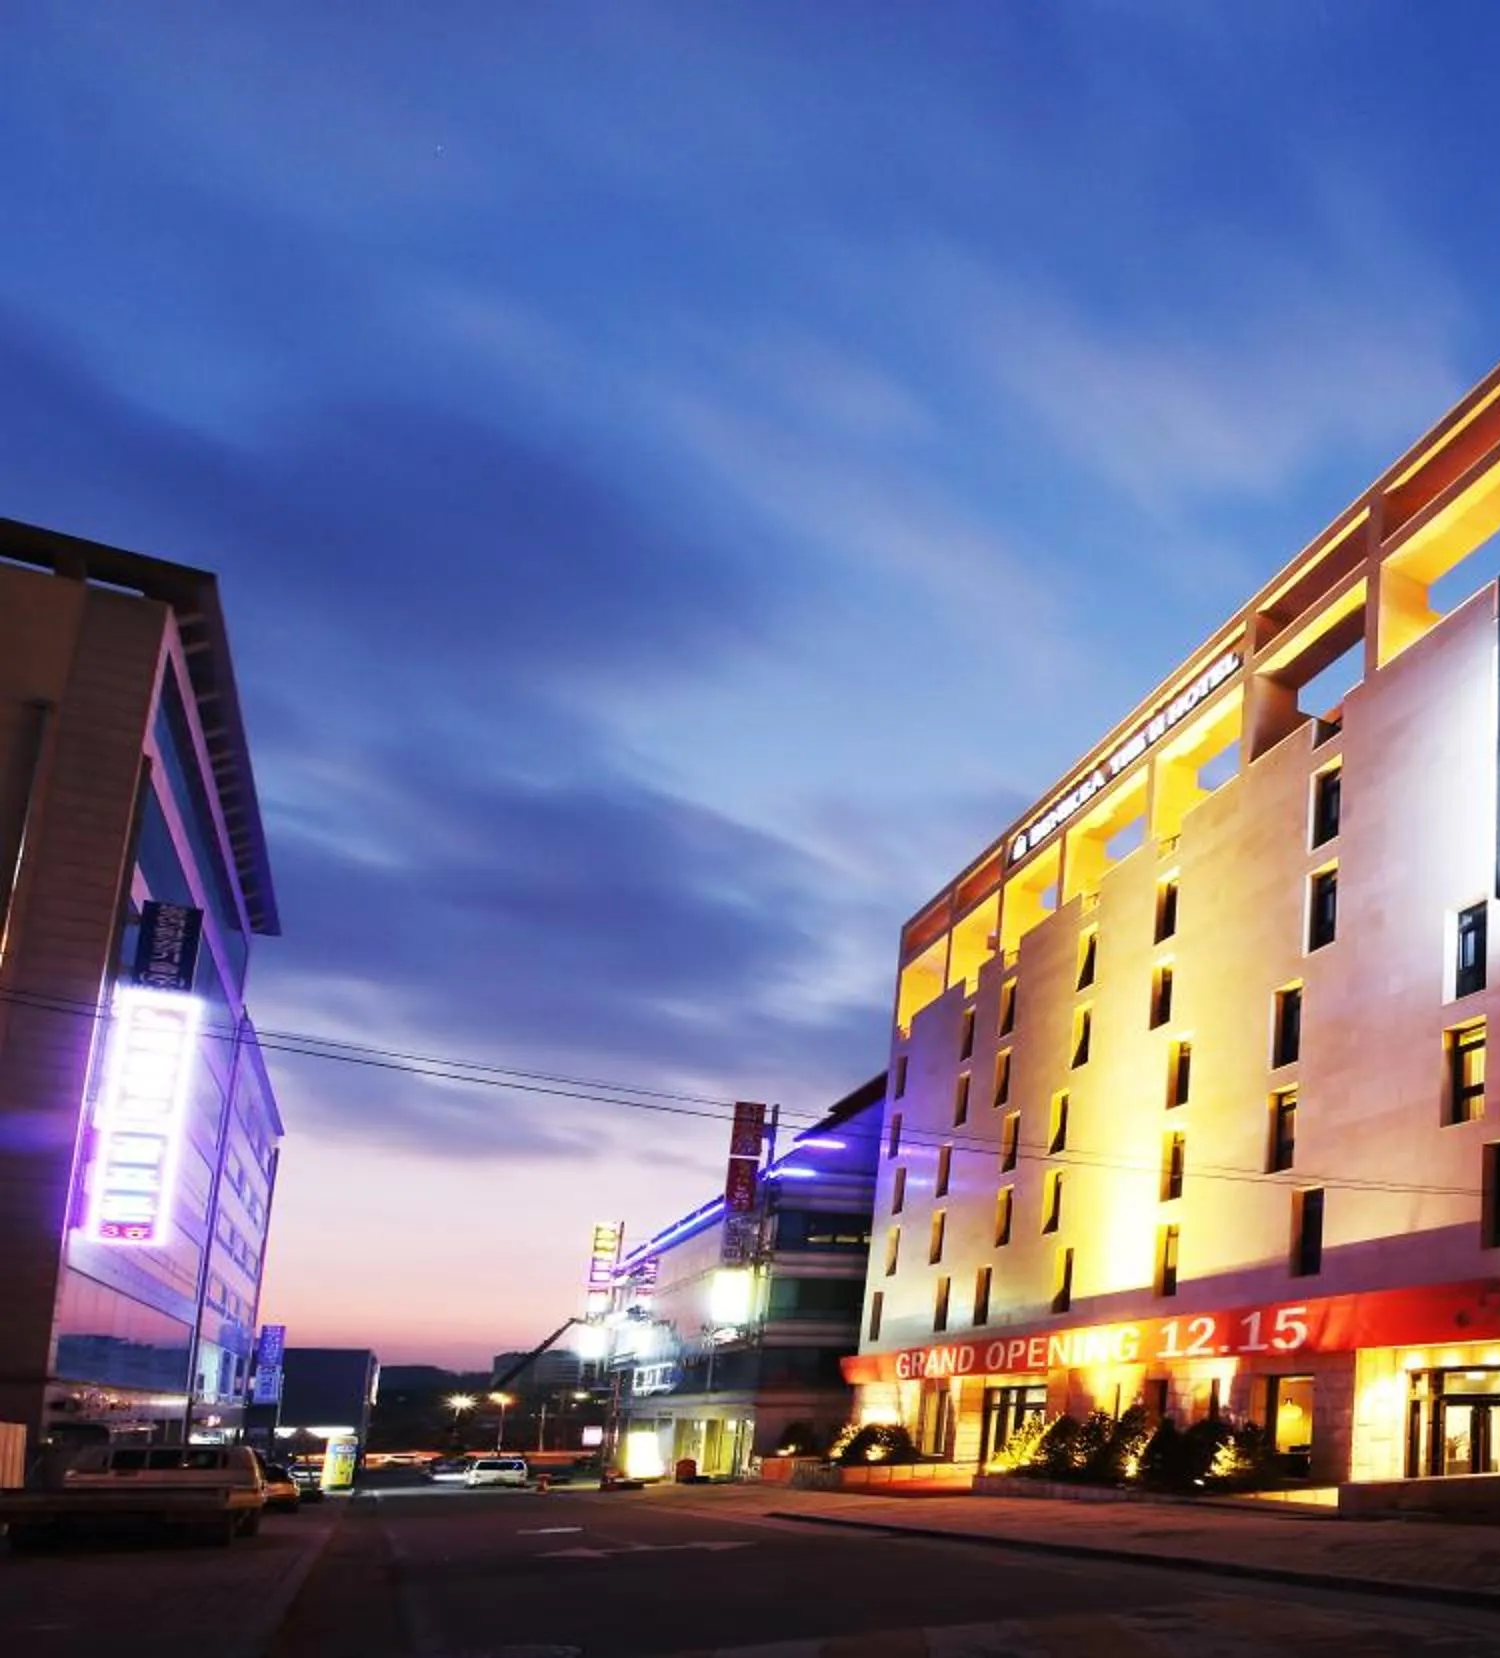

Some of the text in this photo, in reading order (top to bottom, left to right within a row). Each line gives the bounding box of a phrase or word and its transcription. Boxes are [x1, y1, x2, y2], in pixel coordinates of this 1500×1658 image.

[896, 1306, 1309, 1379] GRAND OPENING 12.15
